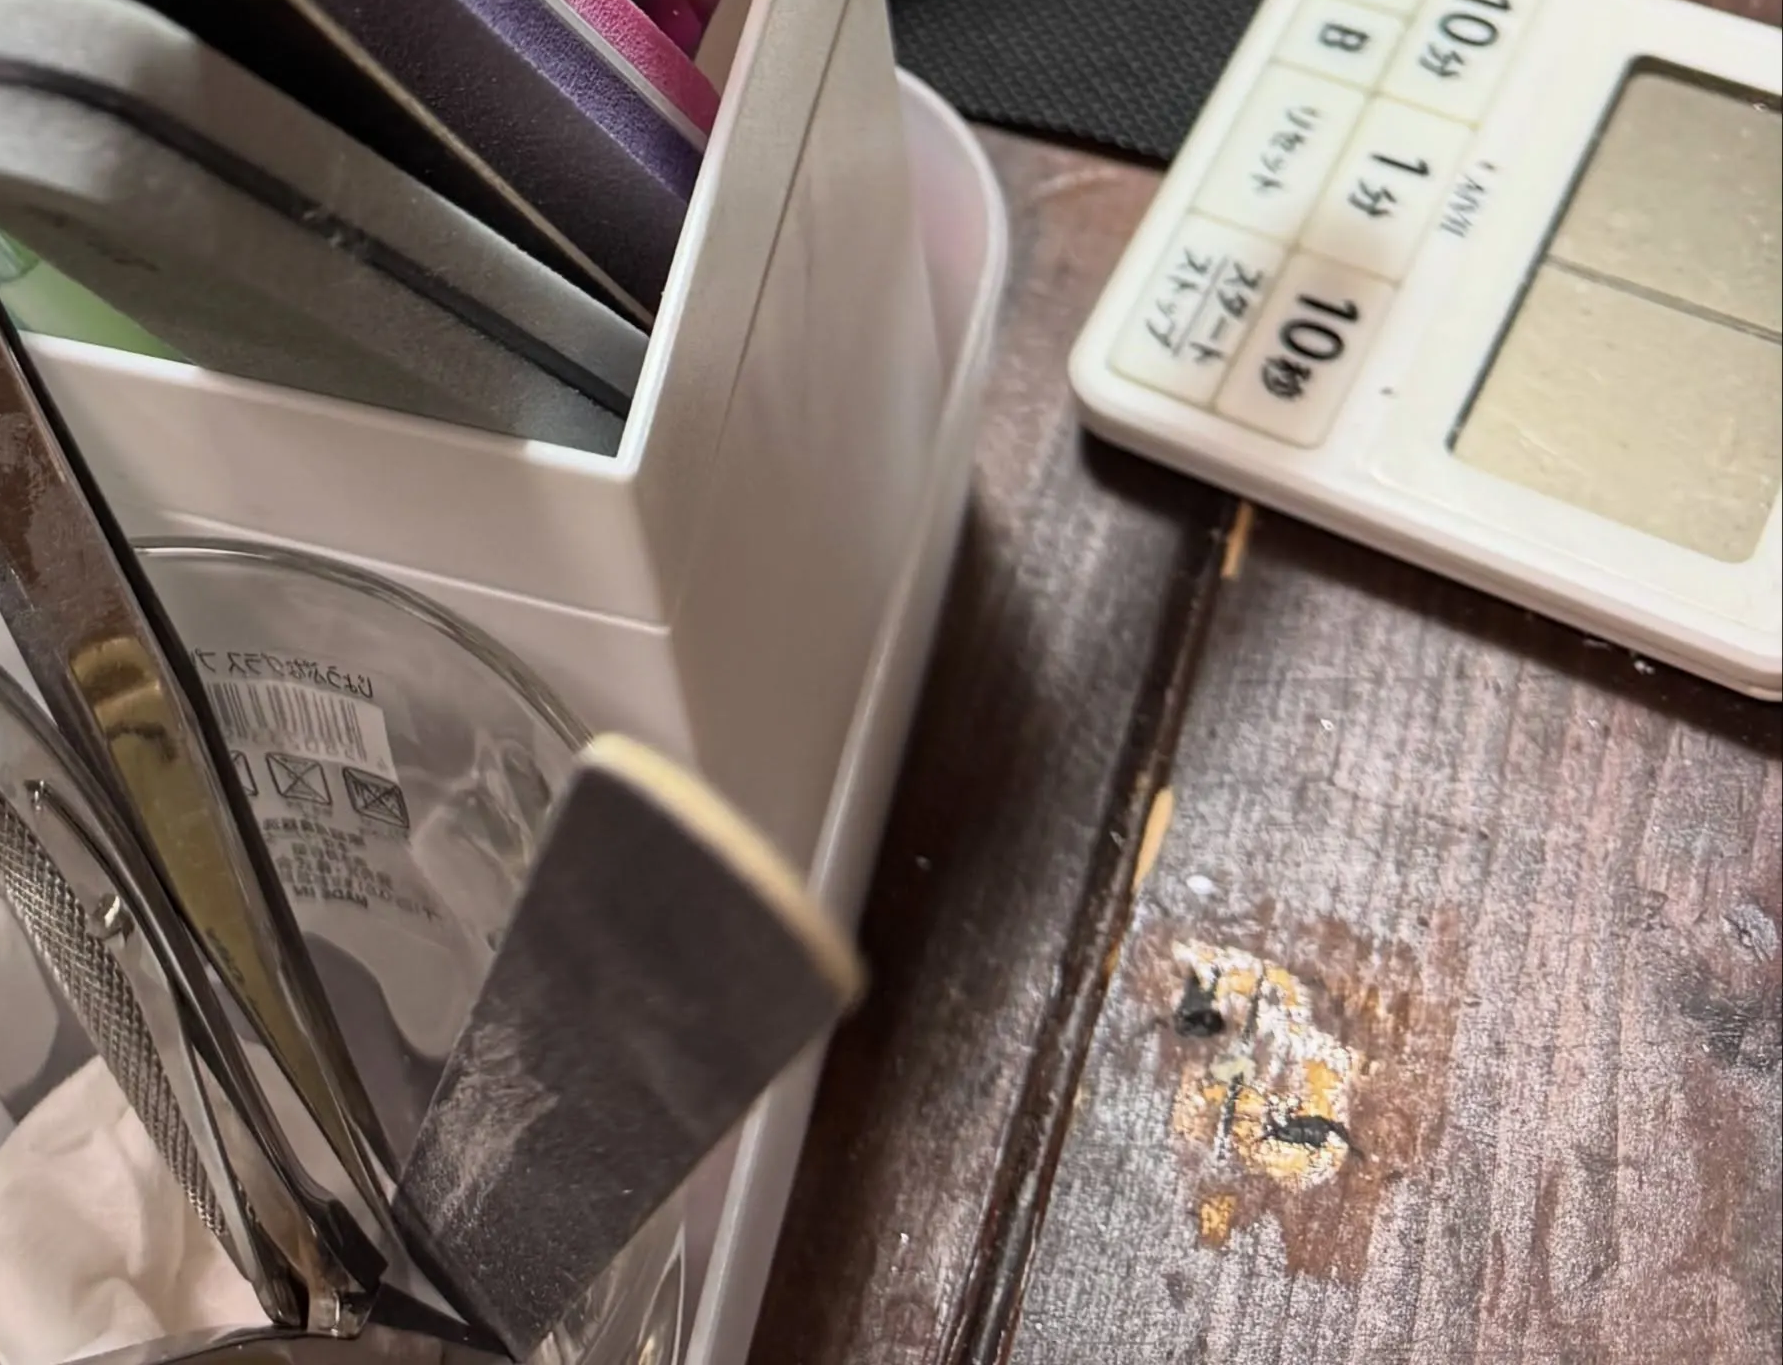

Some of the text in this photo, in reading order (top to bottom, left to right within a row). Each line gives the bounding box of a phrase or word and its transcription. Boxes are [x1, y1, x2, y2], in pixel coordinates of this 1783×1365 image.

[1317, 21, 1369, 55] B
[1348, 150, 1430, 220] 1分
[1261, 291, 1359, 402] 10秒
